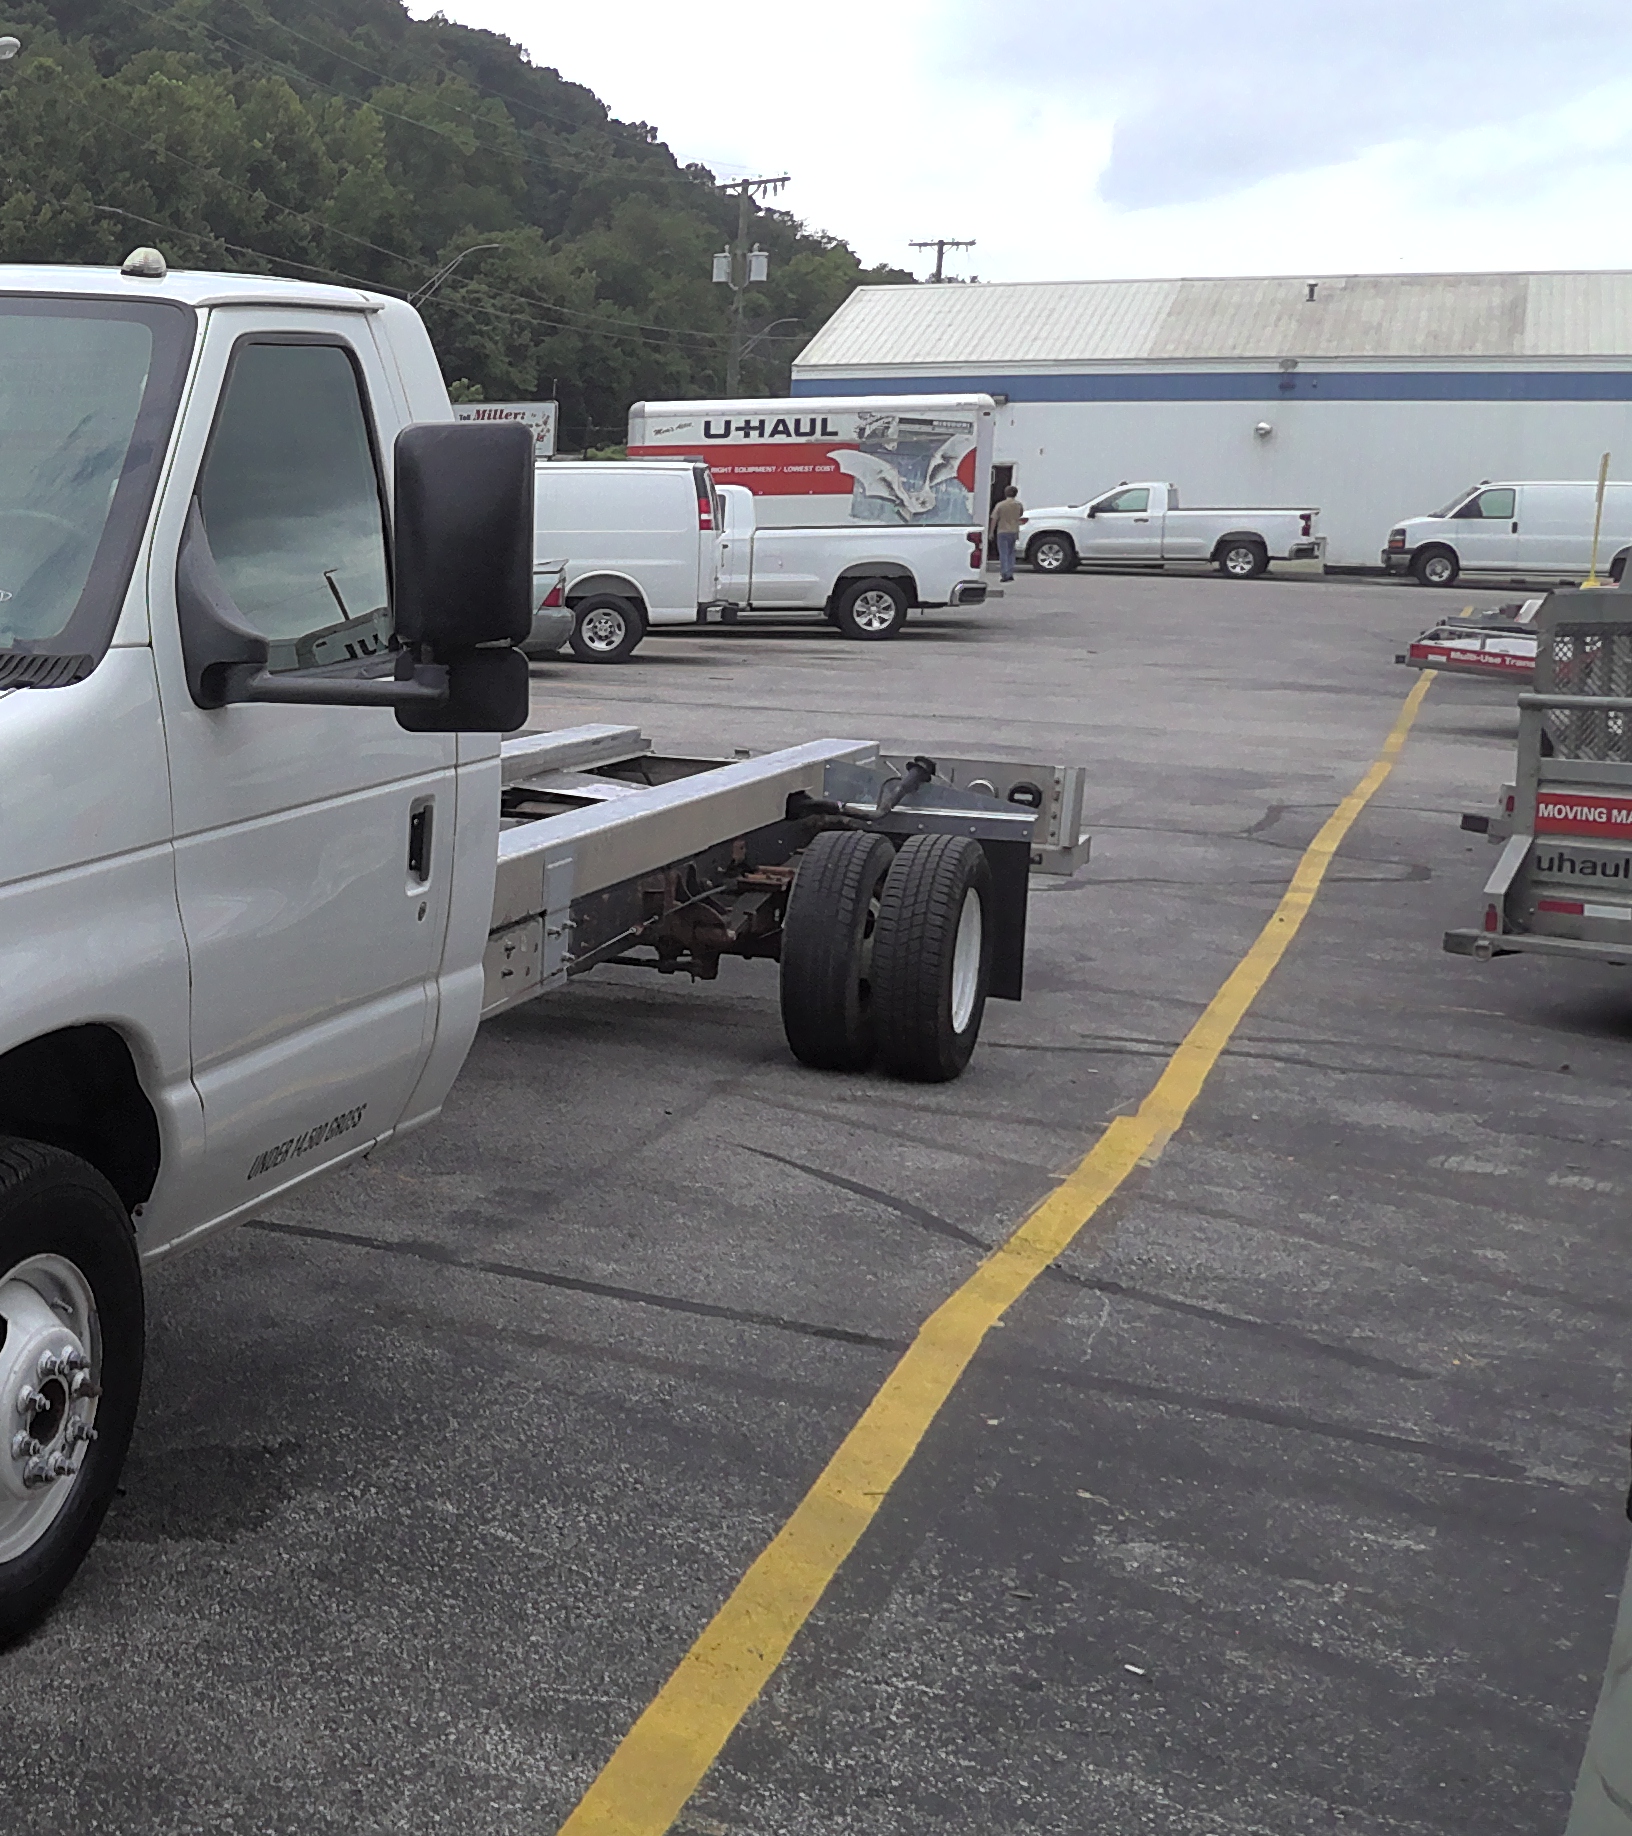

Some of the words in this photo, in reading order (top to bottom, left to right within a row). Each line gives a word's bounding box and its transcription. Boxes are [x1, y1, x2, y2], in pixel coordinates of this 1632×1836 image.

[703, 417, 839, 440] U-HAUL
[783, 465, 814, 473] LOWEST
[1450, 651, 1502, 664] Multi-Use
[1538, 803, 1608, 822] MOVING
